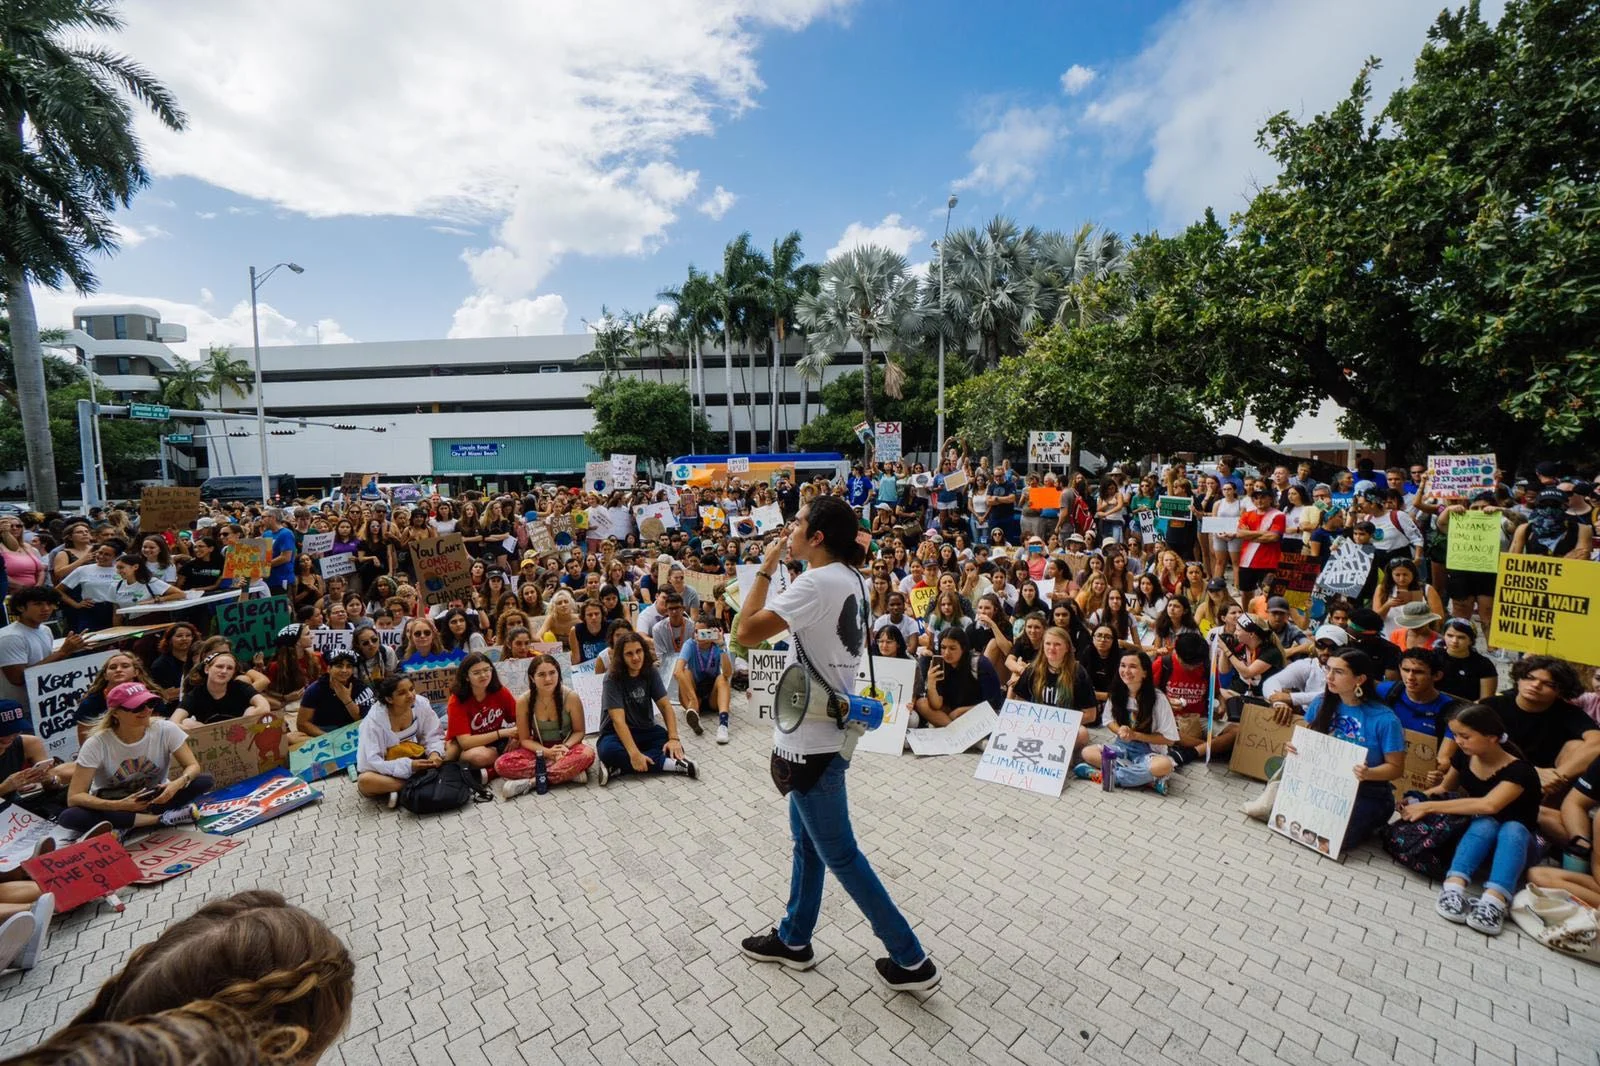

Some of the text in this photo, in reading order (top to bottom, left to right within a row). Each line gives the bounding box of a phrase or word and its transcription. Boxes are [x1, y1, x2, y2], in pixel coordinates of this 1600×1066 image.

[877, 422, 900, 434] SEX
[1037, 454, 1061, 463] PLANET
[1434, 458, 1453, 467] HELP
[1468, 457, 1495, 465] HEAL
[1451, 466, 1481, 476] EARTH
[553, 515, 572, 527] SAVE
[553, 526, 573, 535] OUR
[419, 555, 448, 570] COMB
[434, 560, 462, 576] OVER
[1506, 558, 1563, 576] CLIMATE
[1504, 573, 1549, 591] CRISIS
[425, 585, 473, 605] CHANGE
[1502, 588, 1587, 614] WON'T WAIT.
[224, 599, 288, 622] Clean
[1500, 604, 1556, 625] NEITHER
[314, 632, 344, 644] THE
[1498, 619, 1556, 641] WILL WE.
[751, 671, 781, 681] DIDN'T
[422, 680, 450, 691] TIDE
[470, 706, 503, 731] Cuba
[1005, 702, 1072, 725] DENIAL
[998, 718, 1072, 743] DEADLY
[49, 737, 66, 751] NOT
[299, 739, 330, 754] WE
[982, 753, 1065, 779] CLIMATE CHANGE
[1304, 783, 1350, 819] DIRECTION
[41, 843, 112, 874] Power To
[44, 850, 129, 890] THE POLLS
